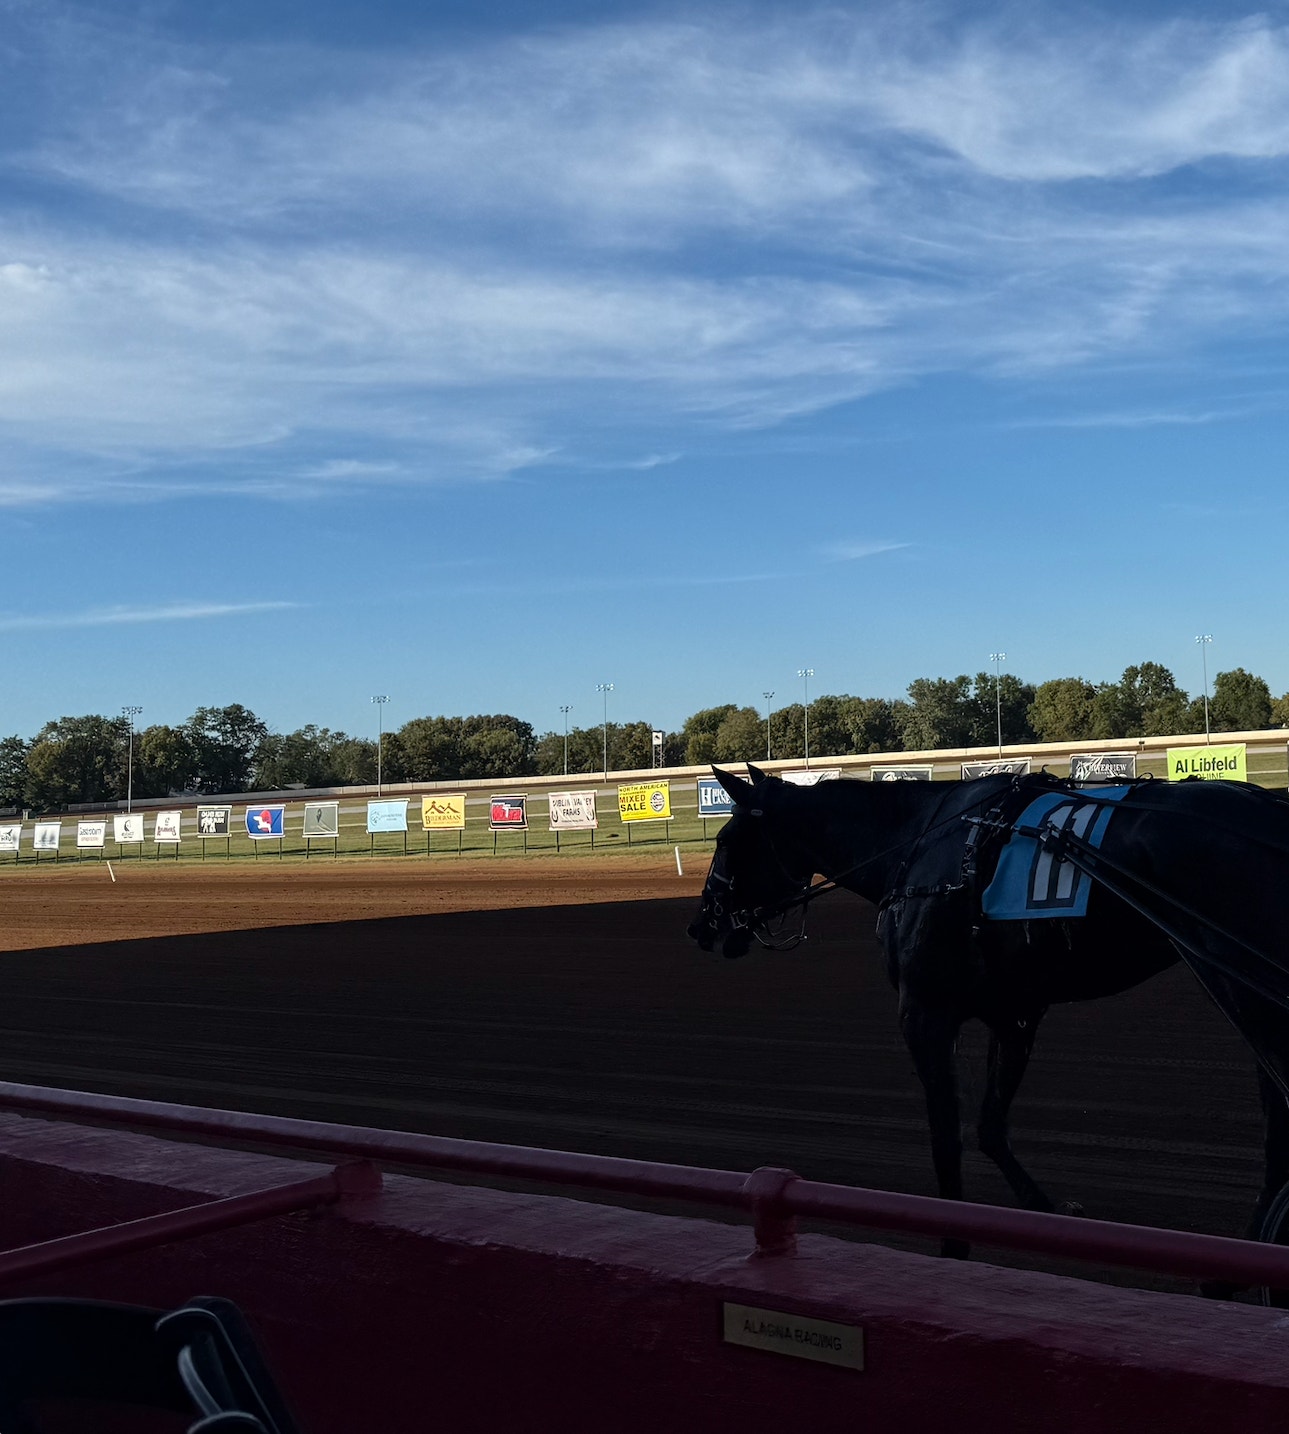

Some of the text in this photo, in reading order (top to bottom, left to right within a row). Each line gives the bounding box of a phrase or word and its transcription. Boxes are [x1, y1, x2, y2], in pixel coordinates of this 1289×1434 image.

[1175, 756, 1237, 773] Al Libfeld
[620, 794, 646, 803] MIXED
[620, 802, 646, 812] SALE
[1032, 803, 1098, 902] 11
